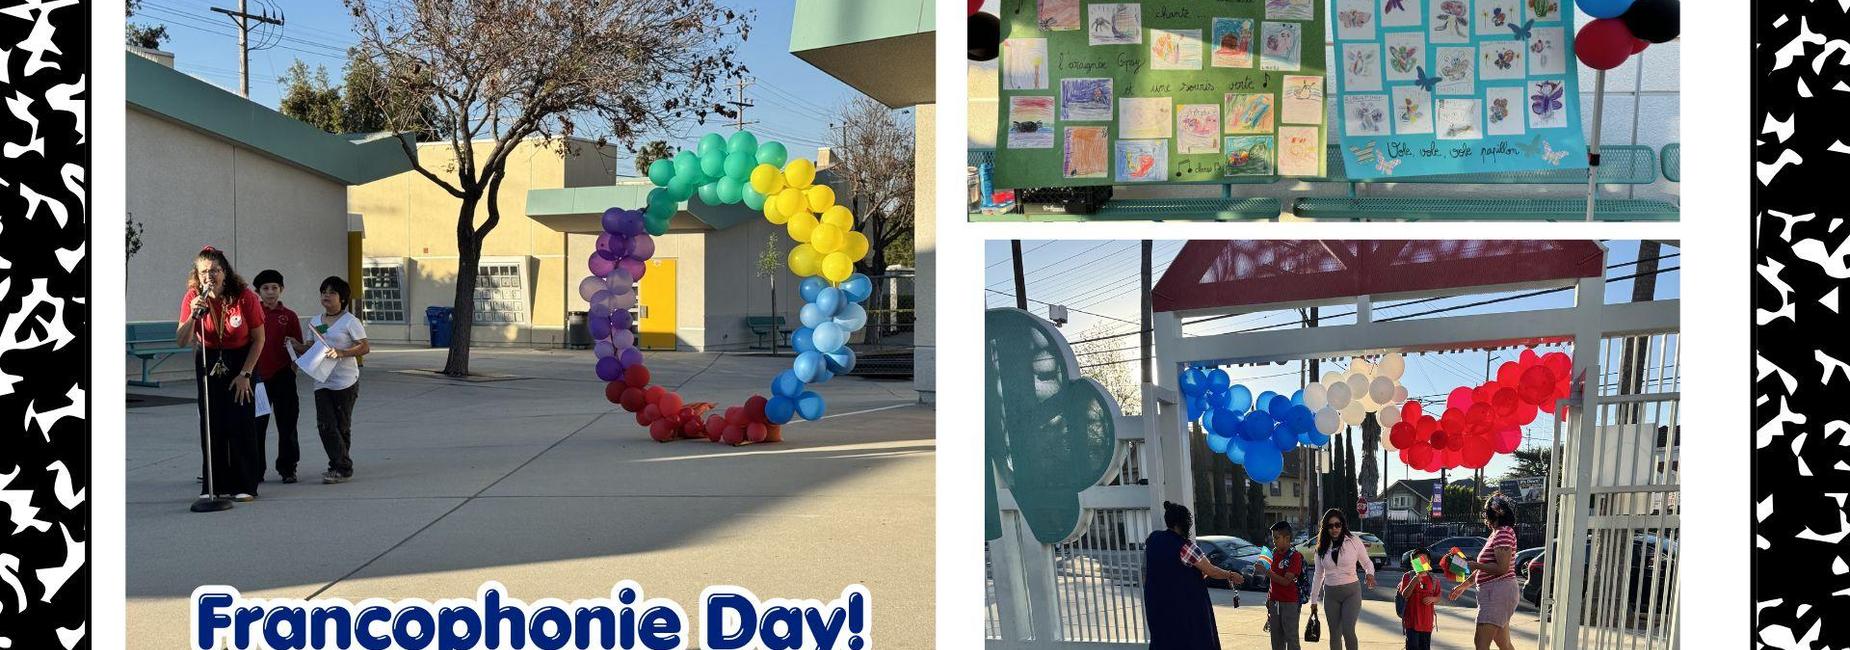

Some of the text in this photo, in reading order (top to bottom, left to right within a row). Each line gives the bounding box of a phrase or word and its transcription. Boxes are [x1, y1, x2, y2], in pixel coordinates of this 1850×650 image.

[1150, 83, 1172, 93] une
[1179, 80, 1216, 93] souris
[1480, 140, 1521, 165] papillon
